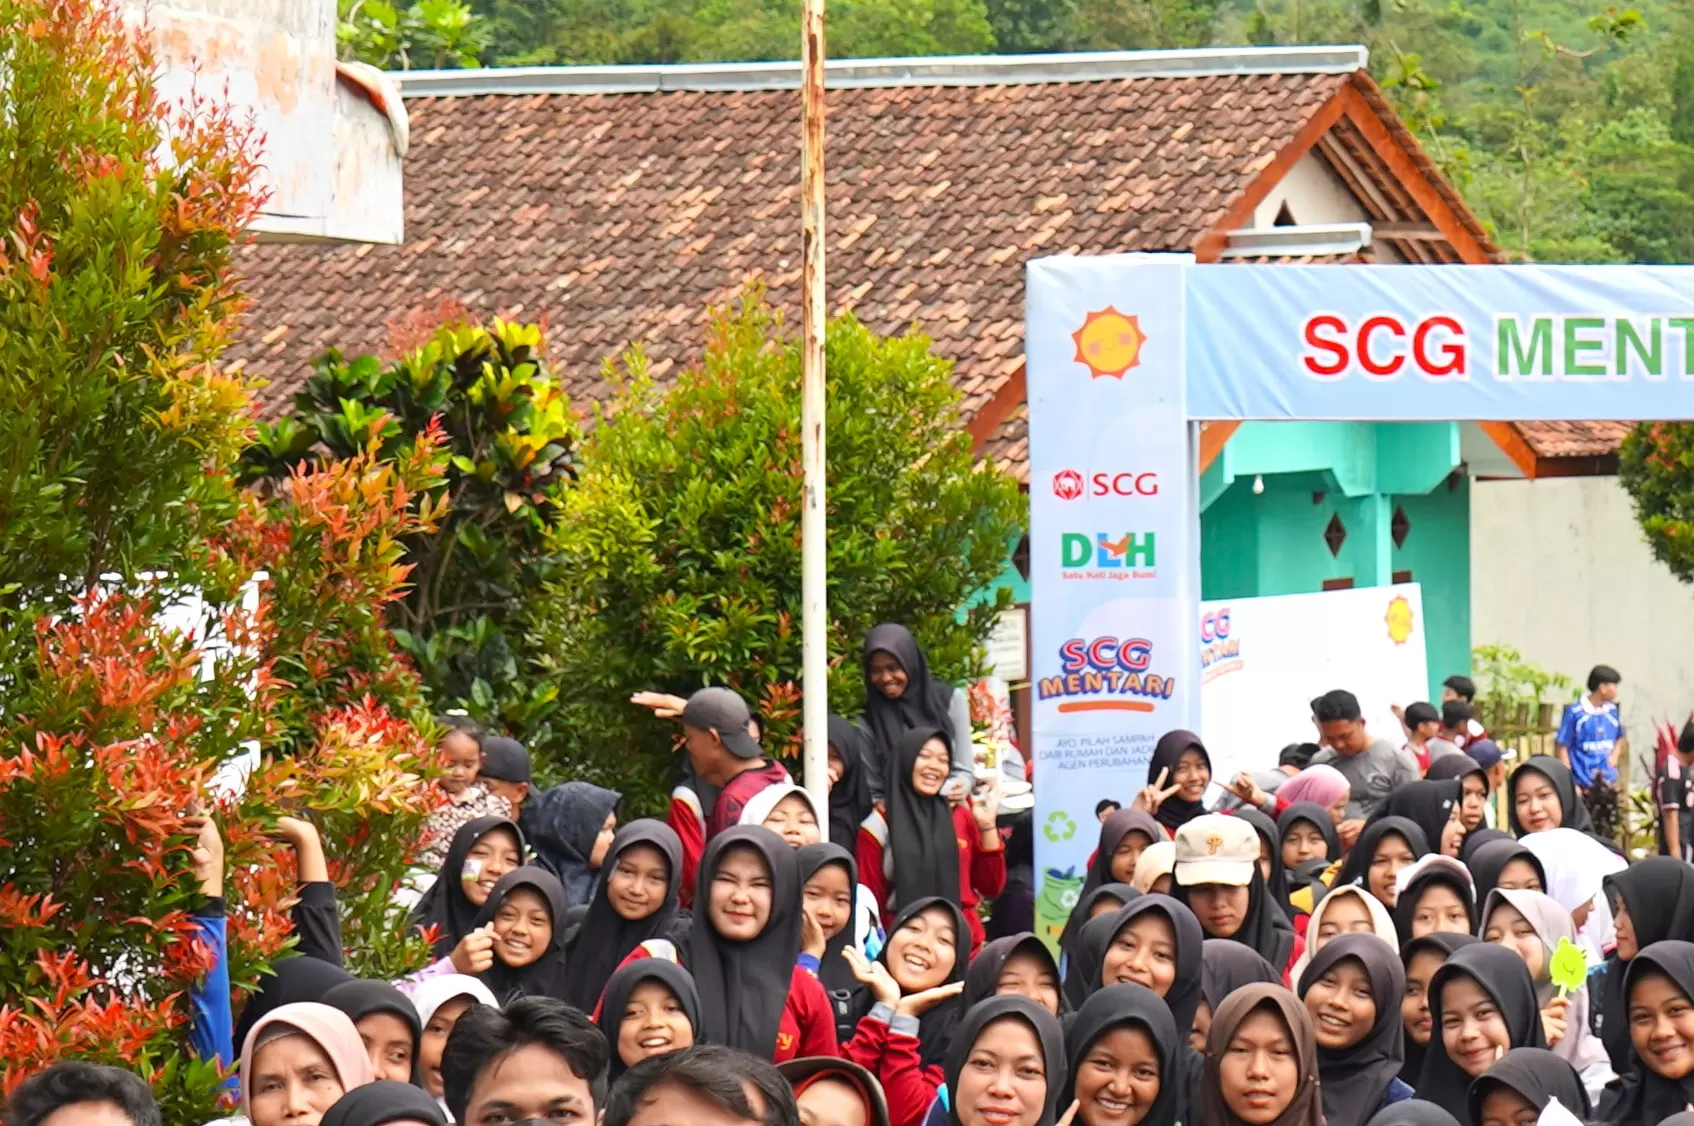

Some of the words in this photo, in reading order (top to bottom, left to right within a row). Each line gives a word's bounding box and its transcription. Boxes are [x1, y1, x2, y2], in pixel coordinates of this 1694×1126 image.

[1303, 315, 1466, 376] SCG
[1092, 472, 1159, 496] SCG
[1061, 532, 1156, 568] DLH
[1200, 608, 1230, 644] CG
[1059, 635, 1153, 673] SCG
[1037, 671, 1176, 701] MENTARI
[1106, 746, 1128, 756] DAN
